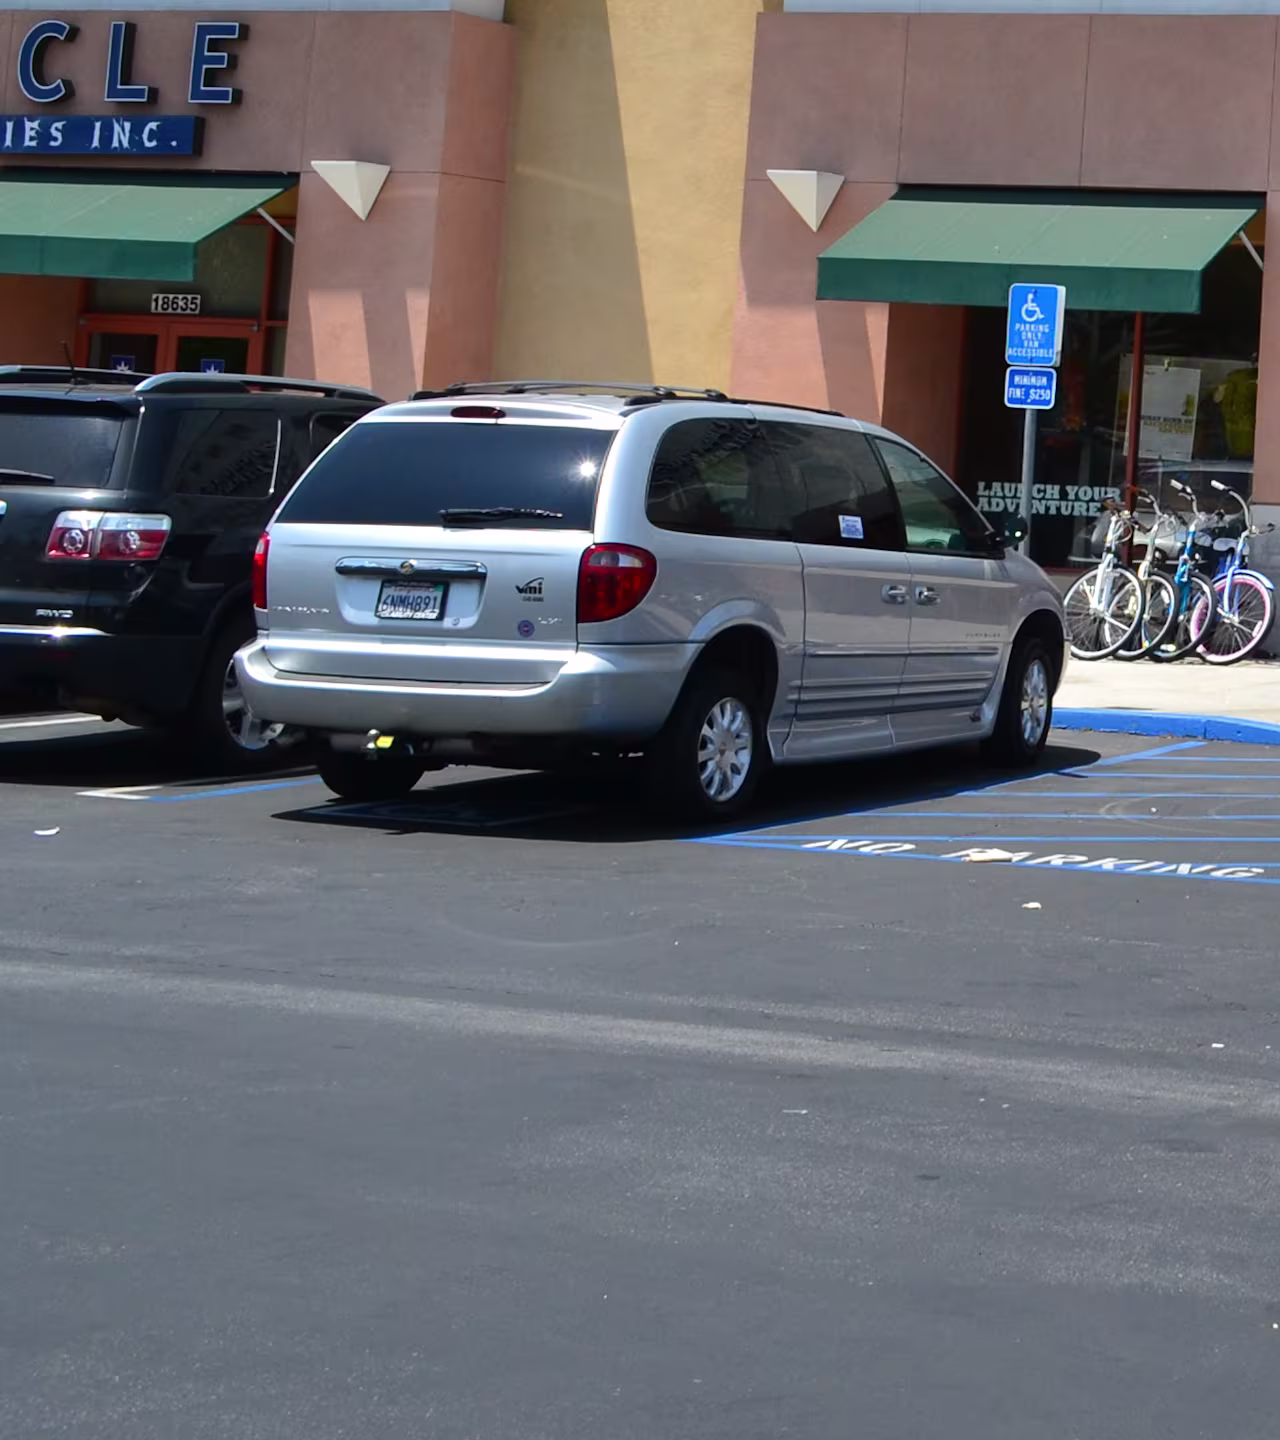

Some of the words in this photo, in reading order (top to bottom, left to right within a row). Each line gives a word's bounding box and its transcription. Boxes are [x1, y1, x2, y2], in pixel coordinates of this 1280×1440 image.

[90, 118, 178, 150] INC.
[152, 295, 200, 313] 18635
[1015, 323, 1049, 333] PARKING
[1021, 332, 1042, 340] ONLY
[1008, 347, 1053, 358] ACCESSIBLE
[1013, 374, 1048, 386] MINIMUM
[1008, 387, 1026, 399] FINE
[1029, 388, 1051, 401] $250
[977, 481, 1061, 499] LAUCH
[978, 497, 1101, 517] ADVNTURE
[381, 593, 438, 613] 6NMH891
[800, 839, 917, 854] NO
